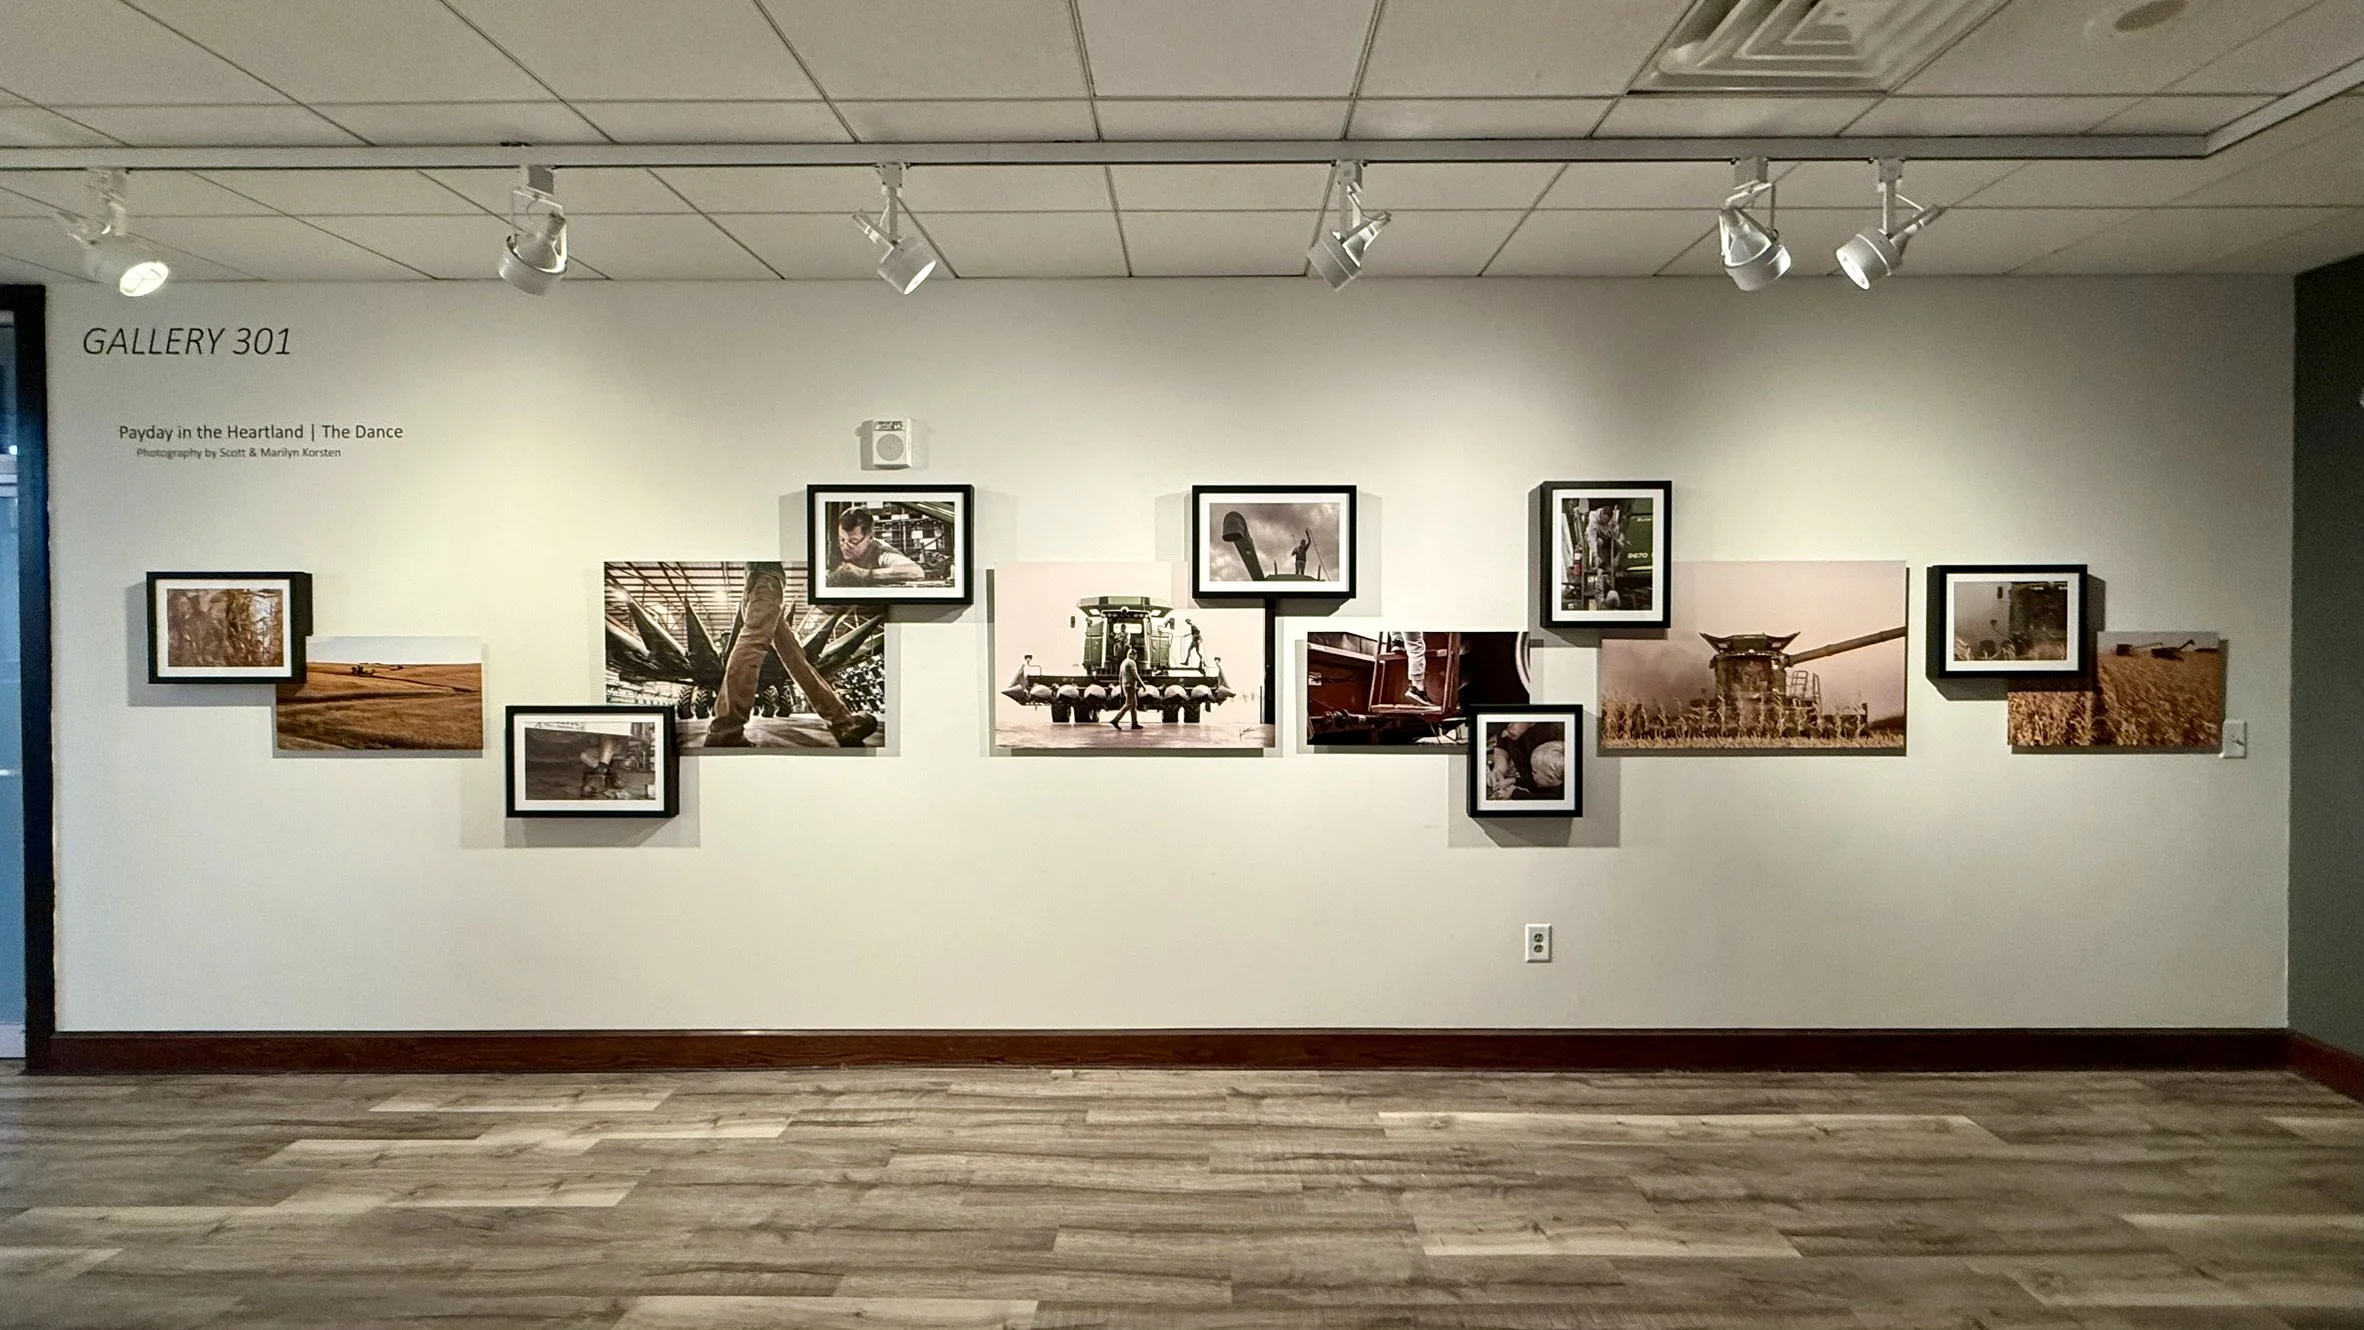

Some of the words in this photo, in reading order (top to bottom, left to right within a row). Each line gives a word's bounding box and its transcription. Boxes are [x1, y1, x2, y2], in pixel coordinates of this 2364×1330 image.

[82, 327, 227, 356] GALLERY
[231, 327, 291, 356] 301
[119, 424, 174, 443] Payday
[177, 424, 192, 439] in
[196, 424, 222, 440] the
[227, 424, 304, 440] Heartland
[321, 424, 350, 439] The
[355, 424, 404, 439] Dance
[136, 447, 202, 460] Photography
[204, 447, 217, 459] by
[219, 447, 246, 458] Scott
[248, 447, 257, 458] &
[260, 447, 300, 459] Marilyn
[302, 447, 342, 458] Korsten
